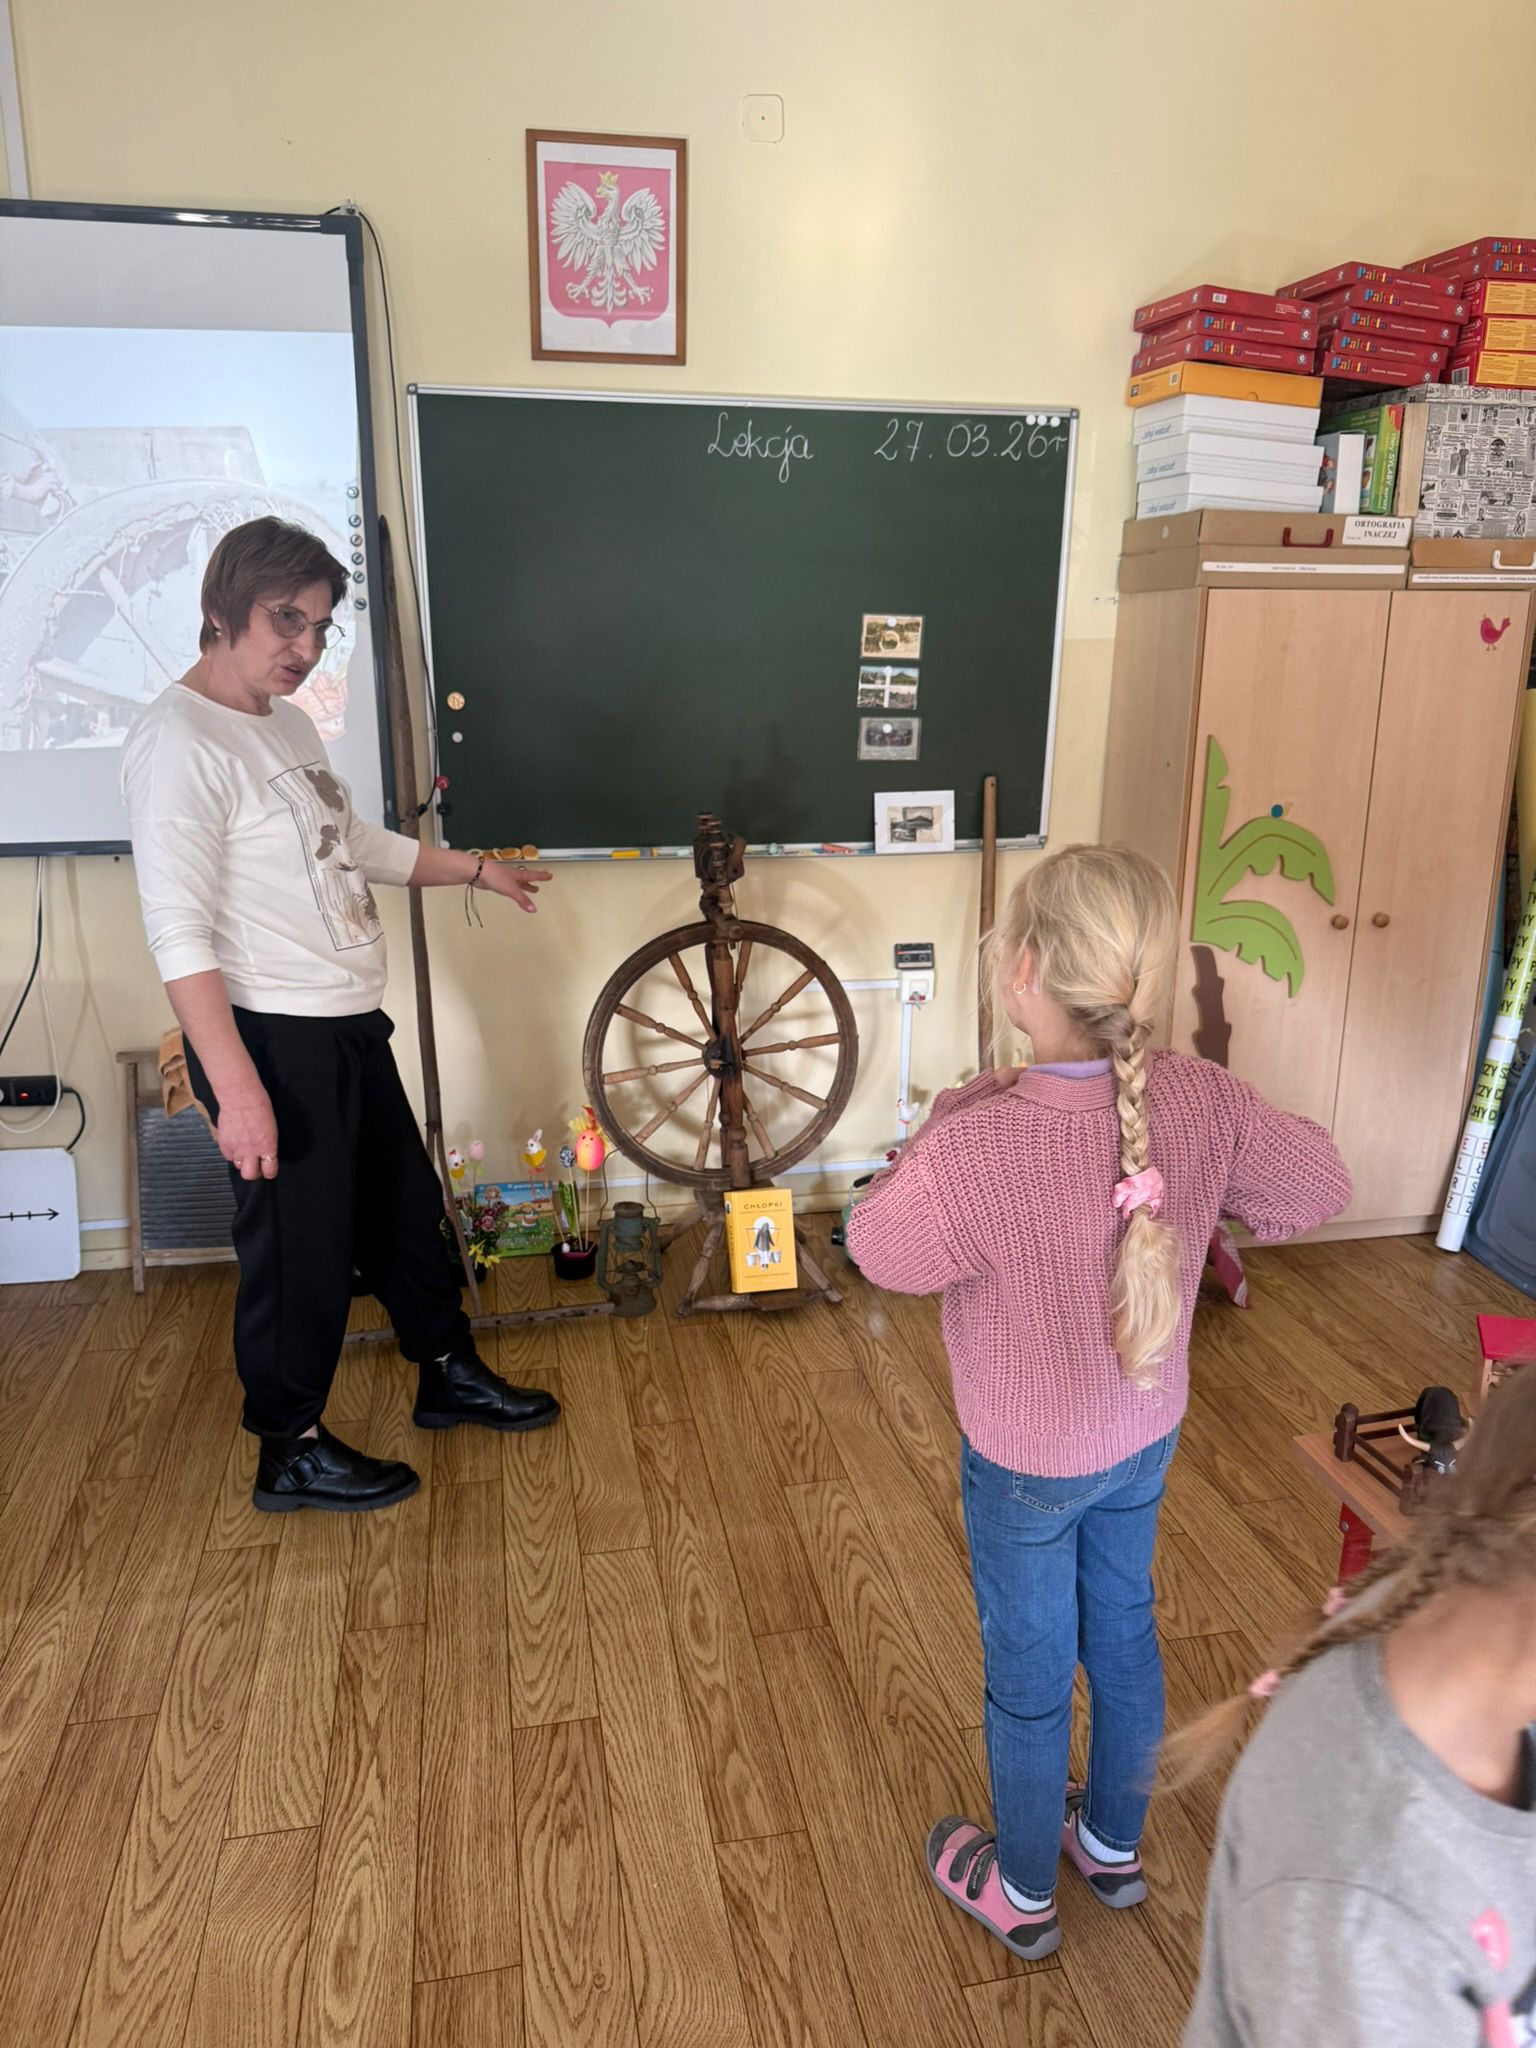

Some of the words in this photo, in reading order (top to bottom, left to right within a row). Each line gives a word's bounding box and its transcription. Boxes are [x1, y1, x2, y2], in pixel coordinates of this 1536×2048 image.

[707, 411, 814, 484] Lekcja
[1354, 520, 1406, 529] ORTOGRAFIA
[1363, 530, 1398, 539] INACZEJ
[743, 1202, 783, 1210] CHŁOPKI
